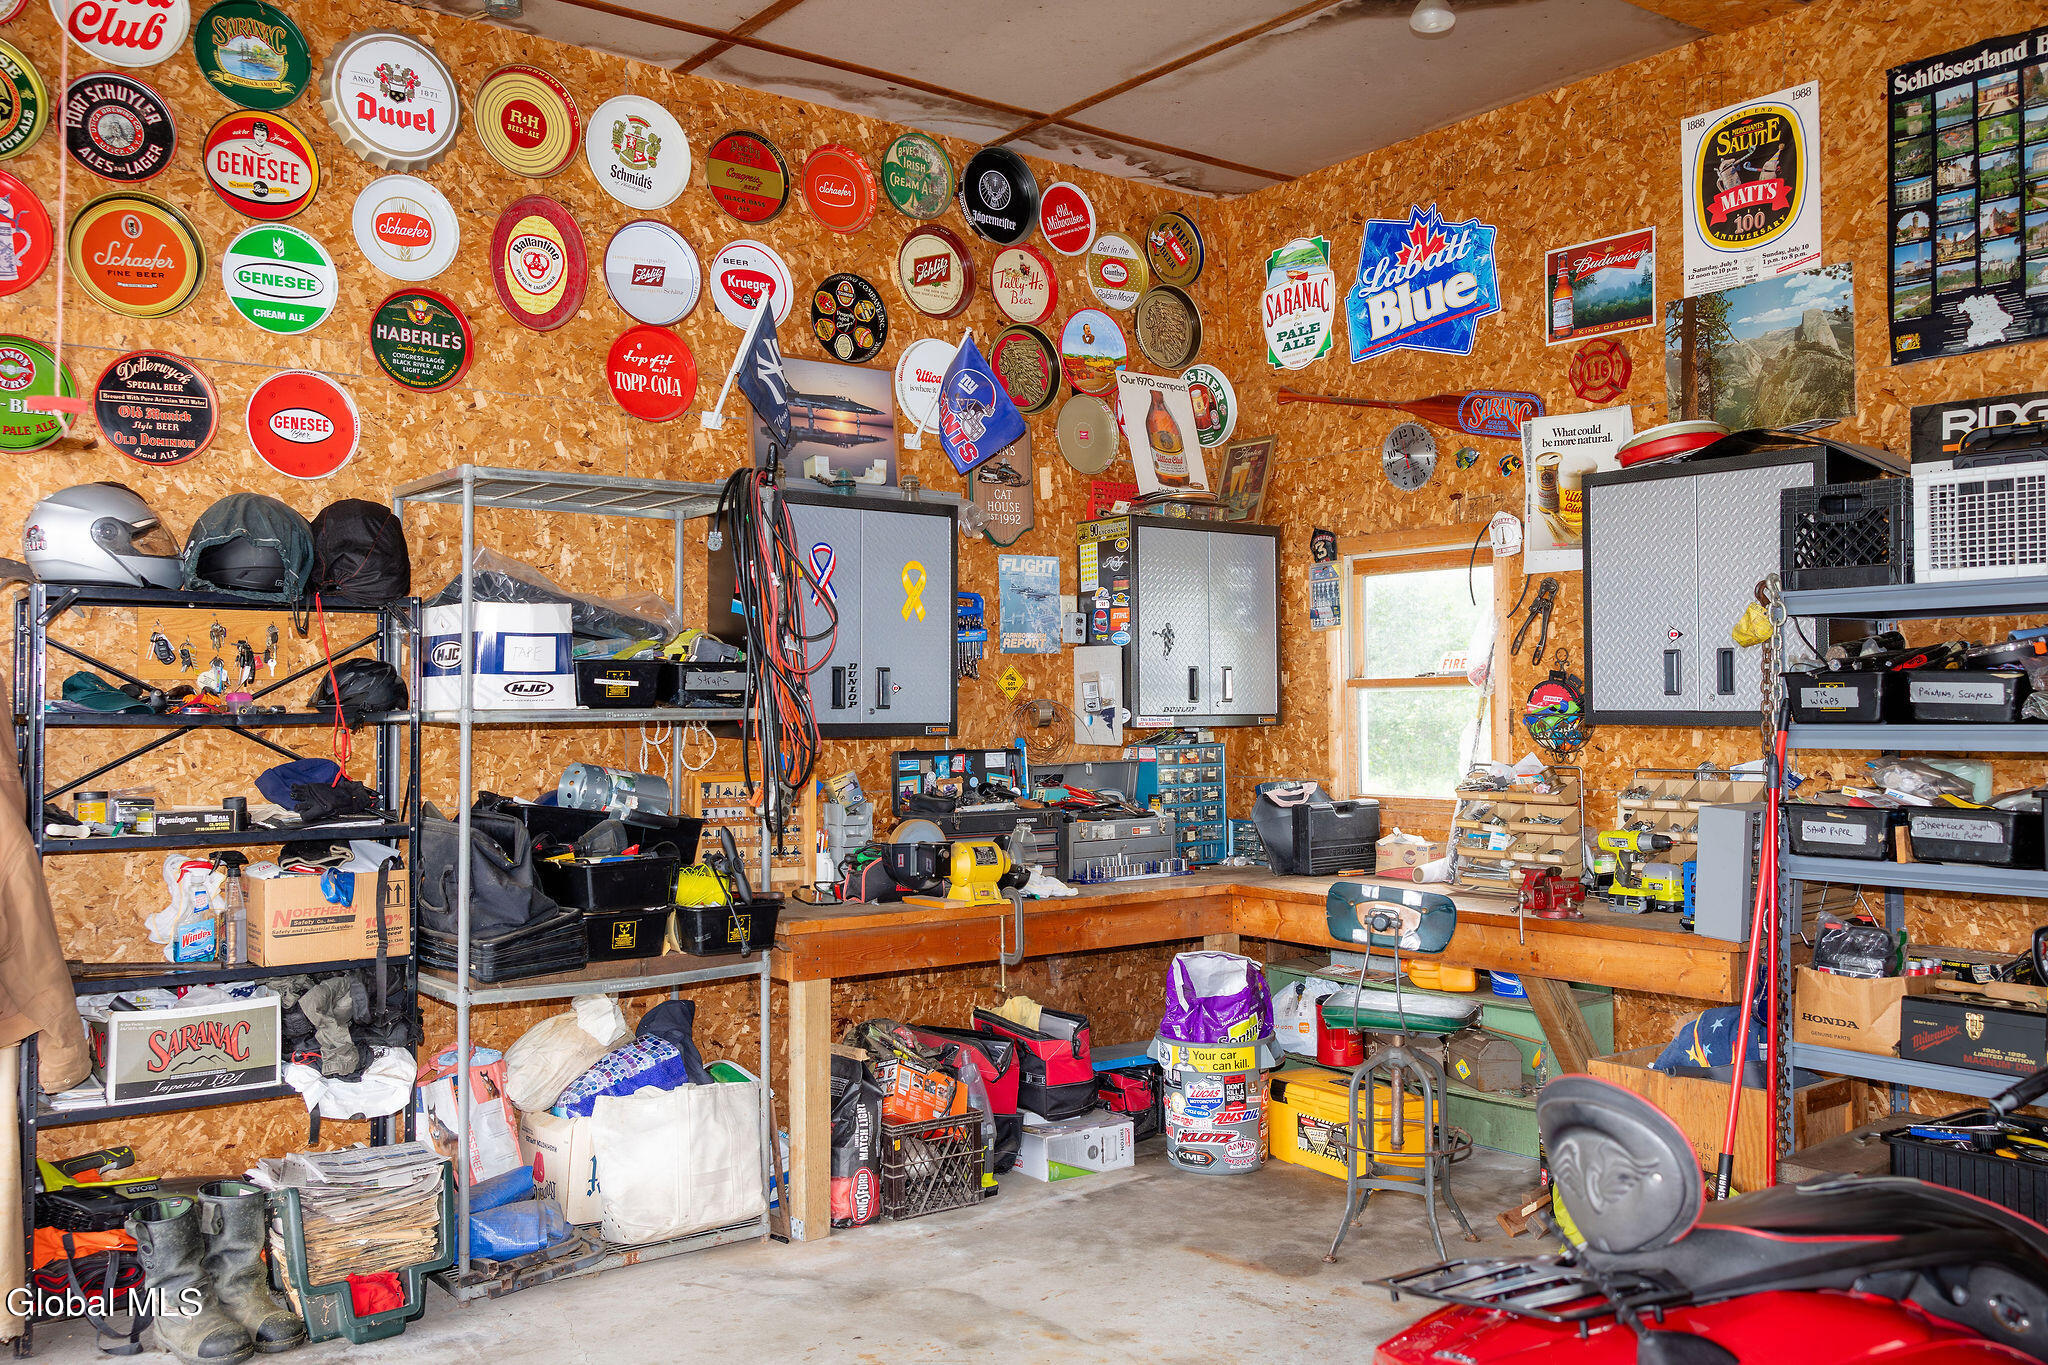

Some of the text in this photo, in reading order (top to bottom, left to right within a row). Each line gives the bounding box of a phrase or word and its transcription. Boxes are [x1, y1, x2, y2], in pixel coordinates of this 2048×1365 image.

[68, 1, 167, 50] Club
[212, 16, 287, 56] SARANAC
[1894, 39, 2028, 95] Schlösserland
[353, 74, 439, 99] ANNO 1871
[66, 83, 163, 128] FORT SCHUYLER
[356, 91, 436, 135] Duvel
[1687, 87, 1812, 131] 1888 1988
[20, 109, 35, 133] ALE
[510, 109, 540, 130] R&H
[1723, 111, 1748, 126] WEST
[1716, 117, 1781, 157] SALUTE
[1732, 121, 1764, 136] MERCHANTS
[77, 146, 114, 174] ALES
[124, 143, 163, 175] LAGER
[217, 150, 300, 185] GENESEE
[903, 157, 926, 172] IRISH
[610, 164, 652, 190] Schmidt's
[726, 167, 763, 184] Congress
[253, 181, 268, 194] Beer
[819, 181, 852, 197] Schaefer
[1720, 182, 1778, 213] MATT'S
[1056, 203, 1069, 217] Old
[379, 213, 430, 240] Schaefer
[1046, 211, 1084, 231] Milwaukee
[1713, 215, 1787, 241] ANNIVERSARY
[1734, 211, 1766, 235] 100
[93, 240, 176, 269] Schaefer
[512, 237, 560, 261] Ballantine
[1098, 242, 1130, 255] Get in the
[1158, 243, 1177, 270] BEER
[1171, 241, 1186, 262] LIGHT
[723, 257, 749, 267] BEER
[1358, 228, 1472, 298] Labatt
[1573, 248, 1649, 274] Budweiser
[107, 270, 165, 279] FINE BEER
[634, 267, 663, 283] Schlitz
[916, 258, 948, 283] Schlitz
[1104, 267, 1126, 278] Gunther
[237, 270, 317, 292] GENESEE
[727, 274, 771, 293] Krueger
[994, 267, 1043, 294] Tally-Ho
[1011, 291, 1033, 305] Beer
[1097, 289, 1136, 303] Golden Mood
[1266, 278, 1330, 328] SARANAC
[252, 308, 305, 323] CREAM ALE
[1365, 271, 1479, 342] Blue
[1277, 322, 1321, 342] PALE
[1578, 326, 1600, 335] KING
[1618, 317, 1649, 328] BEERS
[377, 323, 462, 350] HABERLE'S
[1282, 335, 1316, 352] ALE
[392, 352, 445, 364] CONGRESS LAGER
[393, 359, 411, 367] BLACK
[116, 357, 194, 386] Dotterwyck
[915, 368, 942, 384] Utica
[1585, 360, 1609, 381] 116
[127, 380, 184, 393] SPECIAL BEER
[615, 372, 682, 398] TOPP-COLA
[1120, 374, 1189, 393] Our 1970 compact.
[1198, 369, 1223, 402] BIER
[118, 405, 192, 423] Old Munich
[1468, 397, 1532, 432] SARANAC
[2, 420, 58, 436] PALE ALE
[131, 420, 180, 432] Style BEER
[273, 415, 330, 433] GENESEE
[1552, 424, 1601, 437] What could
[114, 431, 196, 449] OLD DOMINION
[290, 427, 311, 440] Beer
[1542, 432, 1613, 448] be more natural.
[133, 448, 179, 460] Brand ALE
[994, 490, 1013, 500] CAT
[987, 501, 1021, 513] HOUSE
[1090, 523, 1100, 537] 90
[1315, 541, 1327, 559] 3
[1000, 557, 1057, 574] FLIGHT
[1002, 638, 1047, 649] REPORT
[435, 646, 462, 662] HJC
[513, 645, 543, 662] TAPE
[1442, 658, 1467, 670] FIRE
[512, 683, 546, 693] HJC
[847, 663, 858, 708] DUNLOP
[157, 815, 199, 826] Remington
[272, 904, 358, 929] NORTHERN
[182, 929, 213, 948] Windex
[271, 928, 290, 936] Safety
[303, 925, 331, 933] Industrial
[331, 924, 354, 932] Supplies
[1802, 1012, 1859, 1030] HONDA
[1811, 1030, 1851, 1042] GENUINE PARTS
[1912, 1025, 1960, 1048] Milwaukee
[147, 1020, 251, 1073] SARANAC
[1193, 1050, 1237, 1061] Your car
[1213, 1058, 1250, 1071] can kill.
[1973, 1051, 2036, 1065] LIMITED EDITION
[151, 1072, 246, 1094] Imperial IPA
[1190, 1089, 1220, 1098] LUCAS
[1212, 1108, 1260, 1125] AMSOIL
[857, 1103, 869, 1161] MATCH LIGHT
[1180, 1133, 1238, 1144] KLOTZ
[1178, 1152, 1205, 1162] KME
[855, 1173, 871, 1220] KINGSFORD
